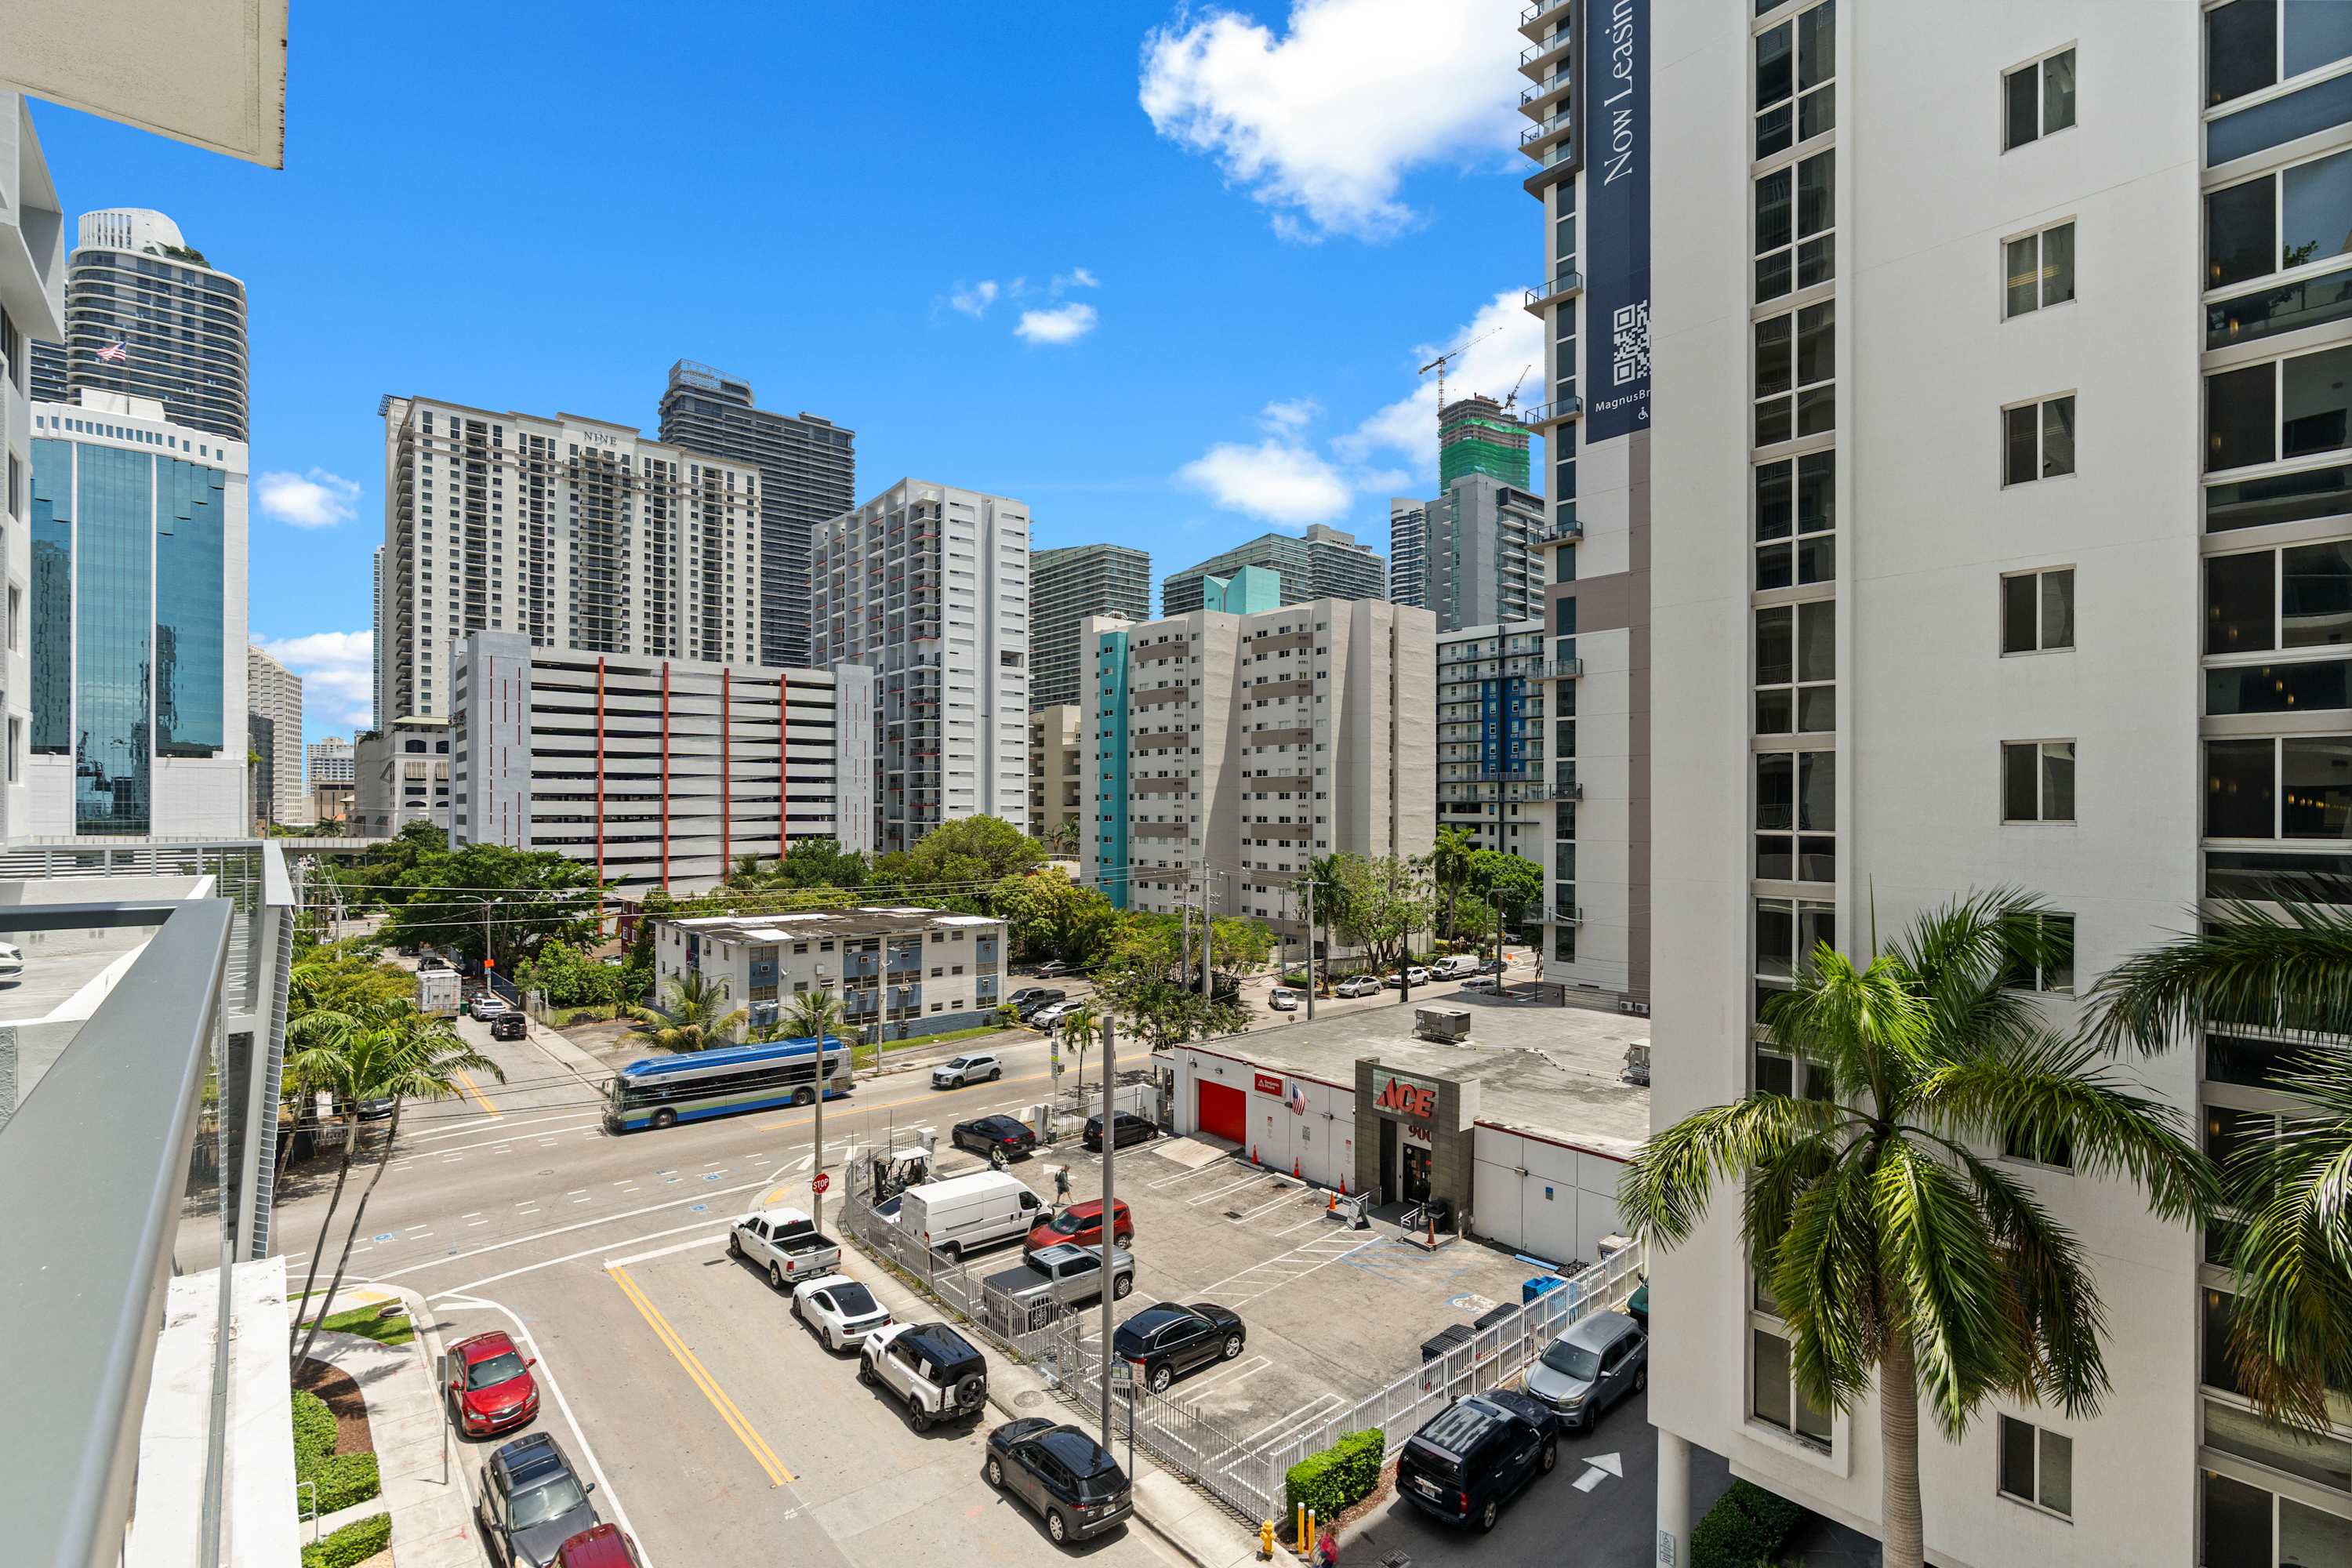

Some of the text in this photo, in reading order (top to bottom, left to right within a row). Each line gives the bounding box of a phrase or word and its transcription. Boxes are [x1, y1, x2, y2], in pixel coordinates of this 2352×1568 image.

[1604, 109, 1633, 186] Now
[583, 431, 618, 446] NINE
[1375, 1077, 1436, 1117] ACE
[813, 1178, 829, 1190] STOP
